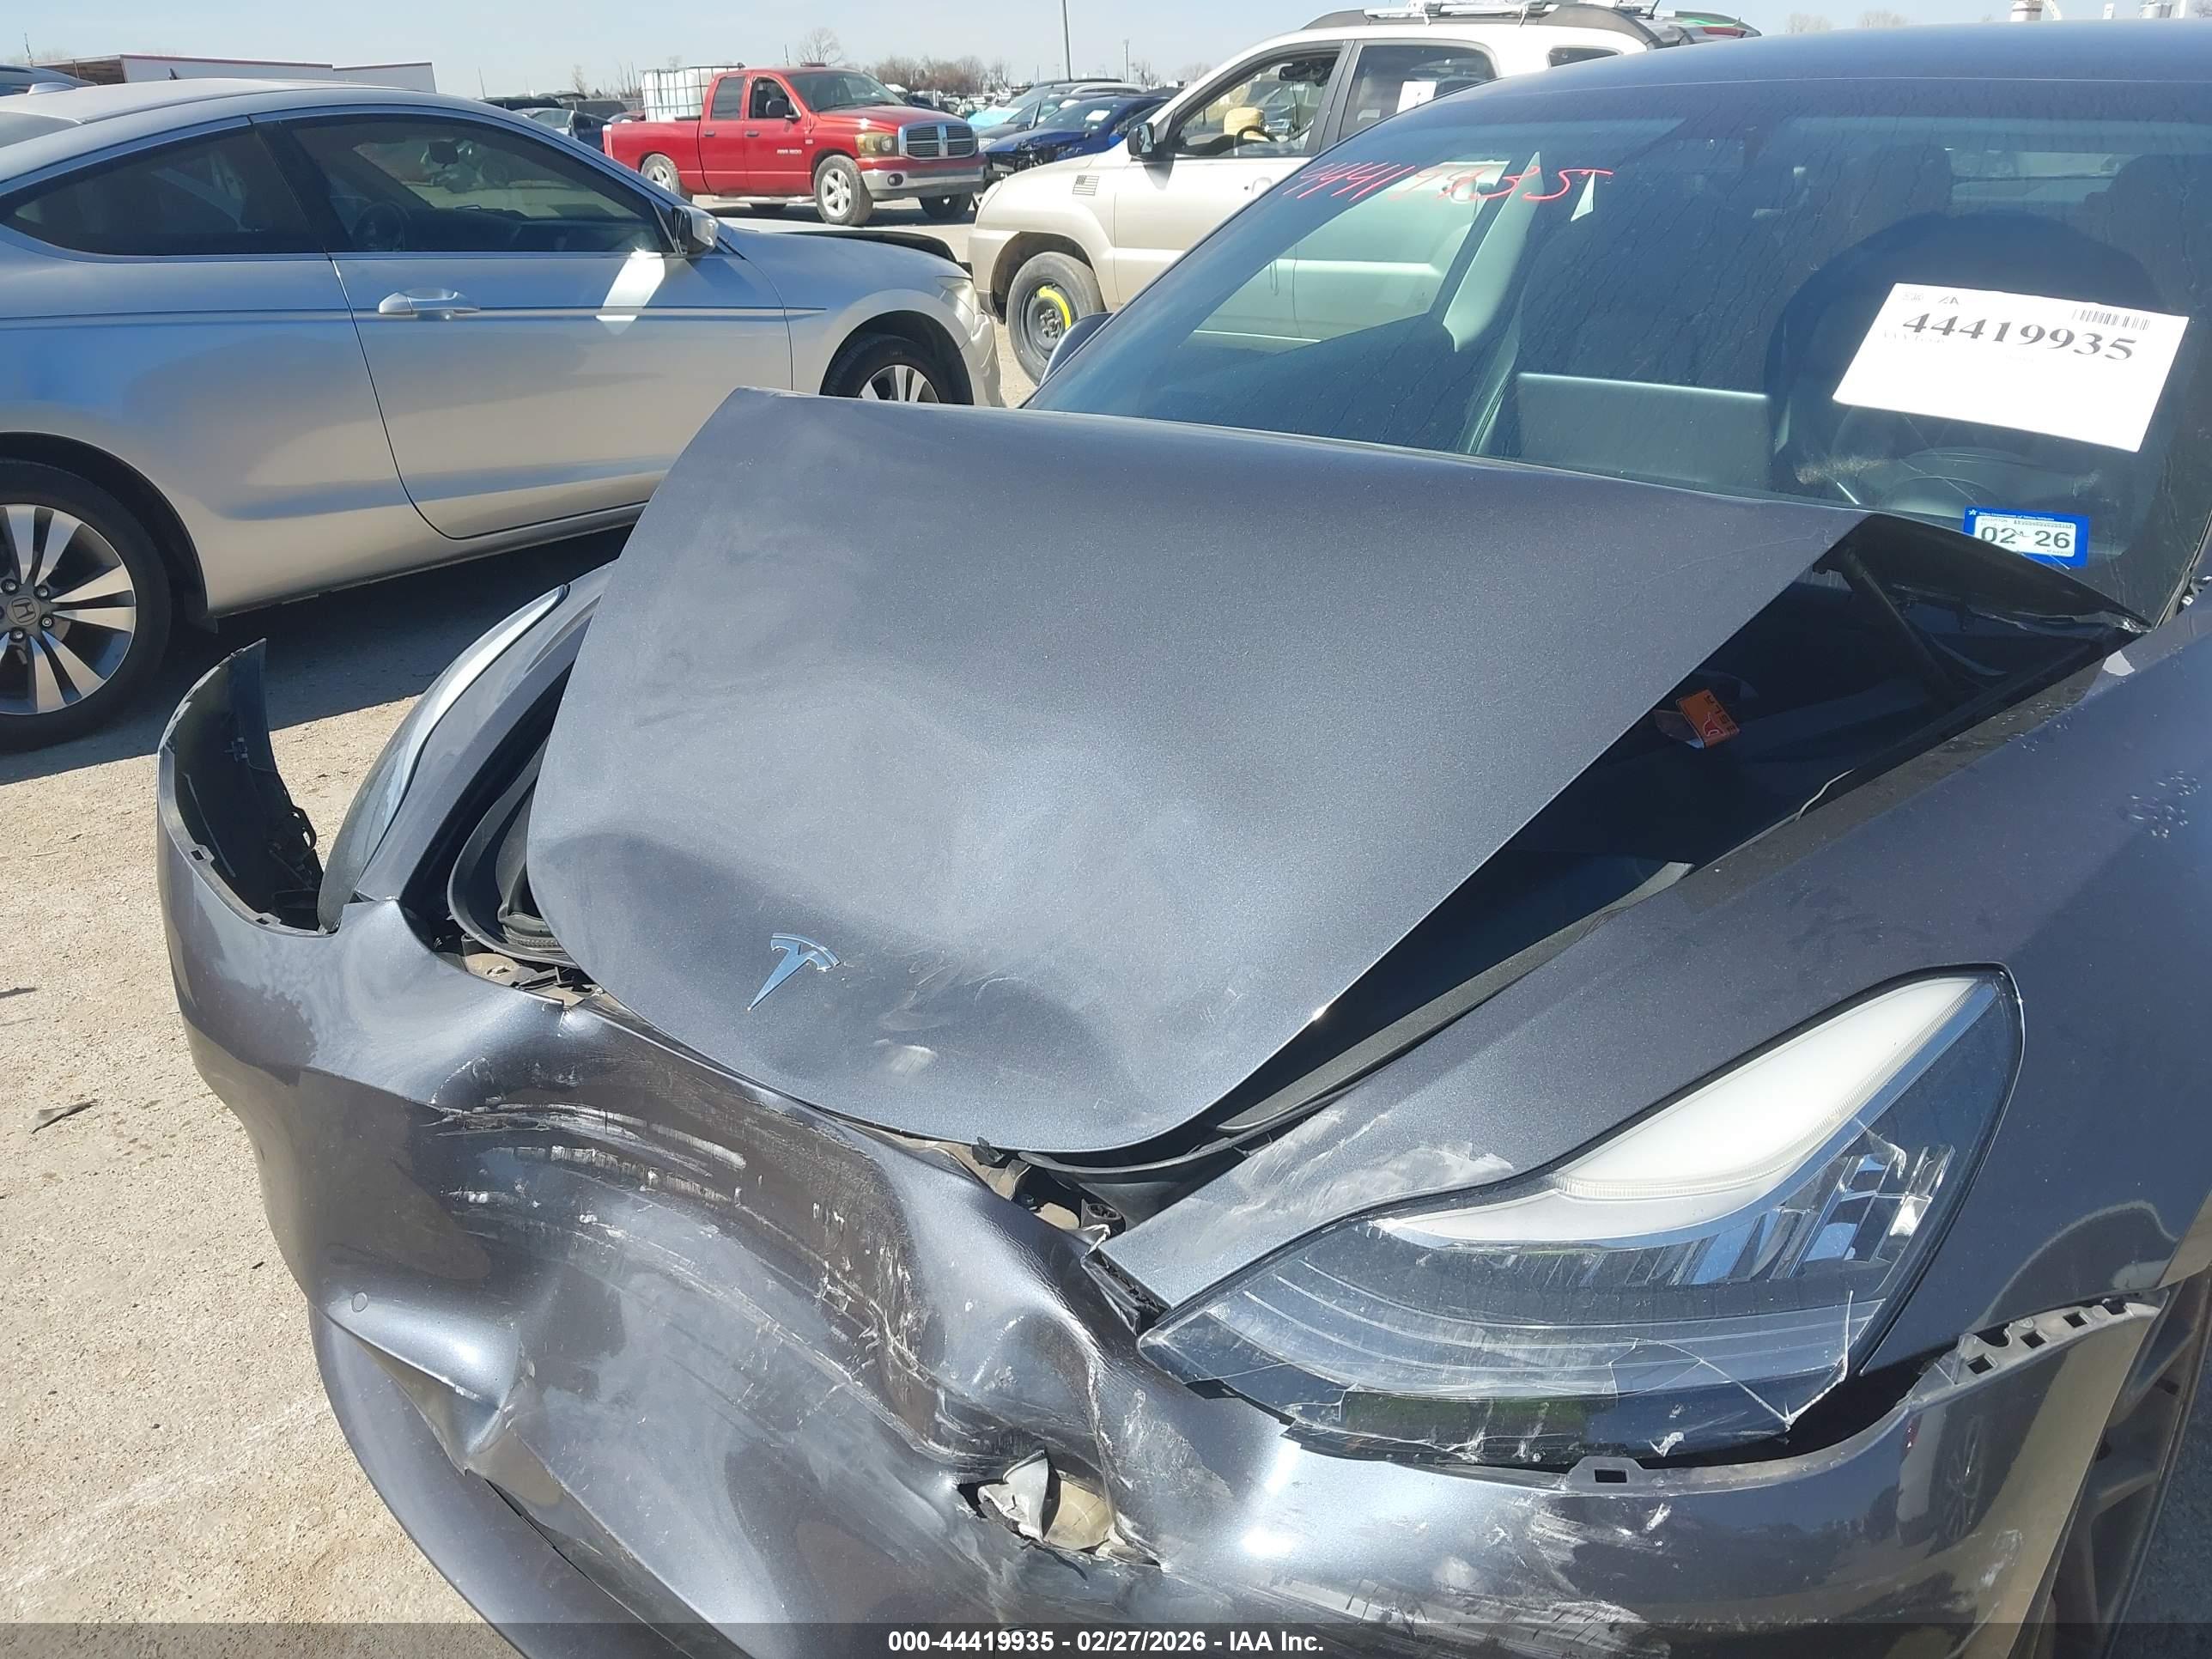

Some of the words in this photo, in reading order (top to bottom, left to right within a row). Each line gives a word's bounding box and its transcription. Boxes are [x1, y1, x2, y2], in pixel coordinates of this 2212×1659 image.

[1901, 312, 2138, 362] 44419935
[1980, 526, 2017, 545] 02
[2033, 530, 2071, 550] 26
